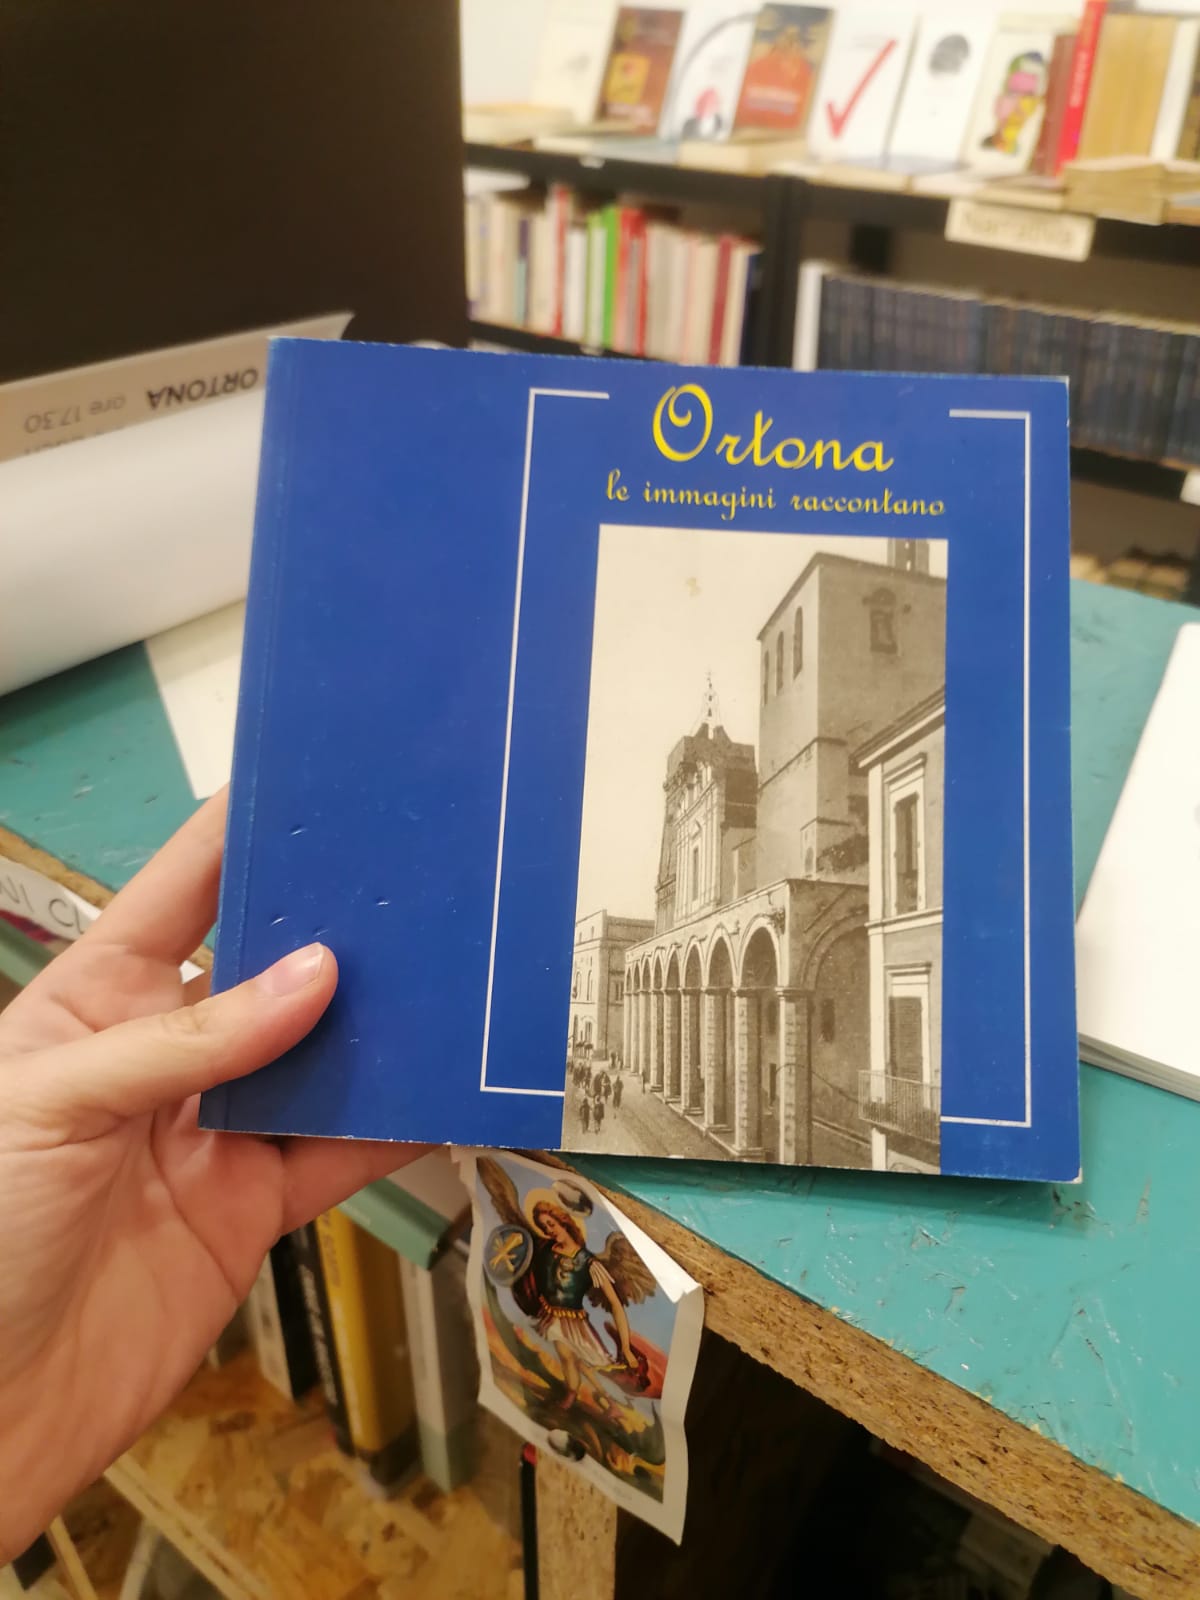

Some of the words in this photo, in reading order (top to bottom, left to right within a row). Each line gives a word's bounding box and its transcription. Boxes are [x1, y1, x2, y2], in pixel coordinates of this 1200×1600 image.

[88, 393, 126, 416] ore
[147, 368, 259, 410] ORTONA
[652, 383, 894, 472] Ortona
[605, 468, 630, 501] le
[643, 481, 777, 521] immagini
[790, 488, 946, 517] raccontano
